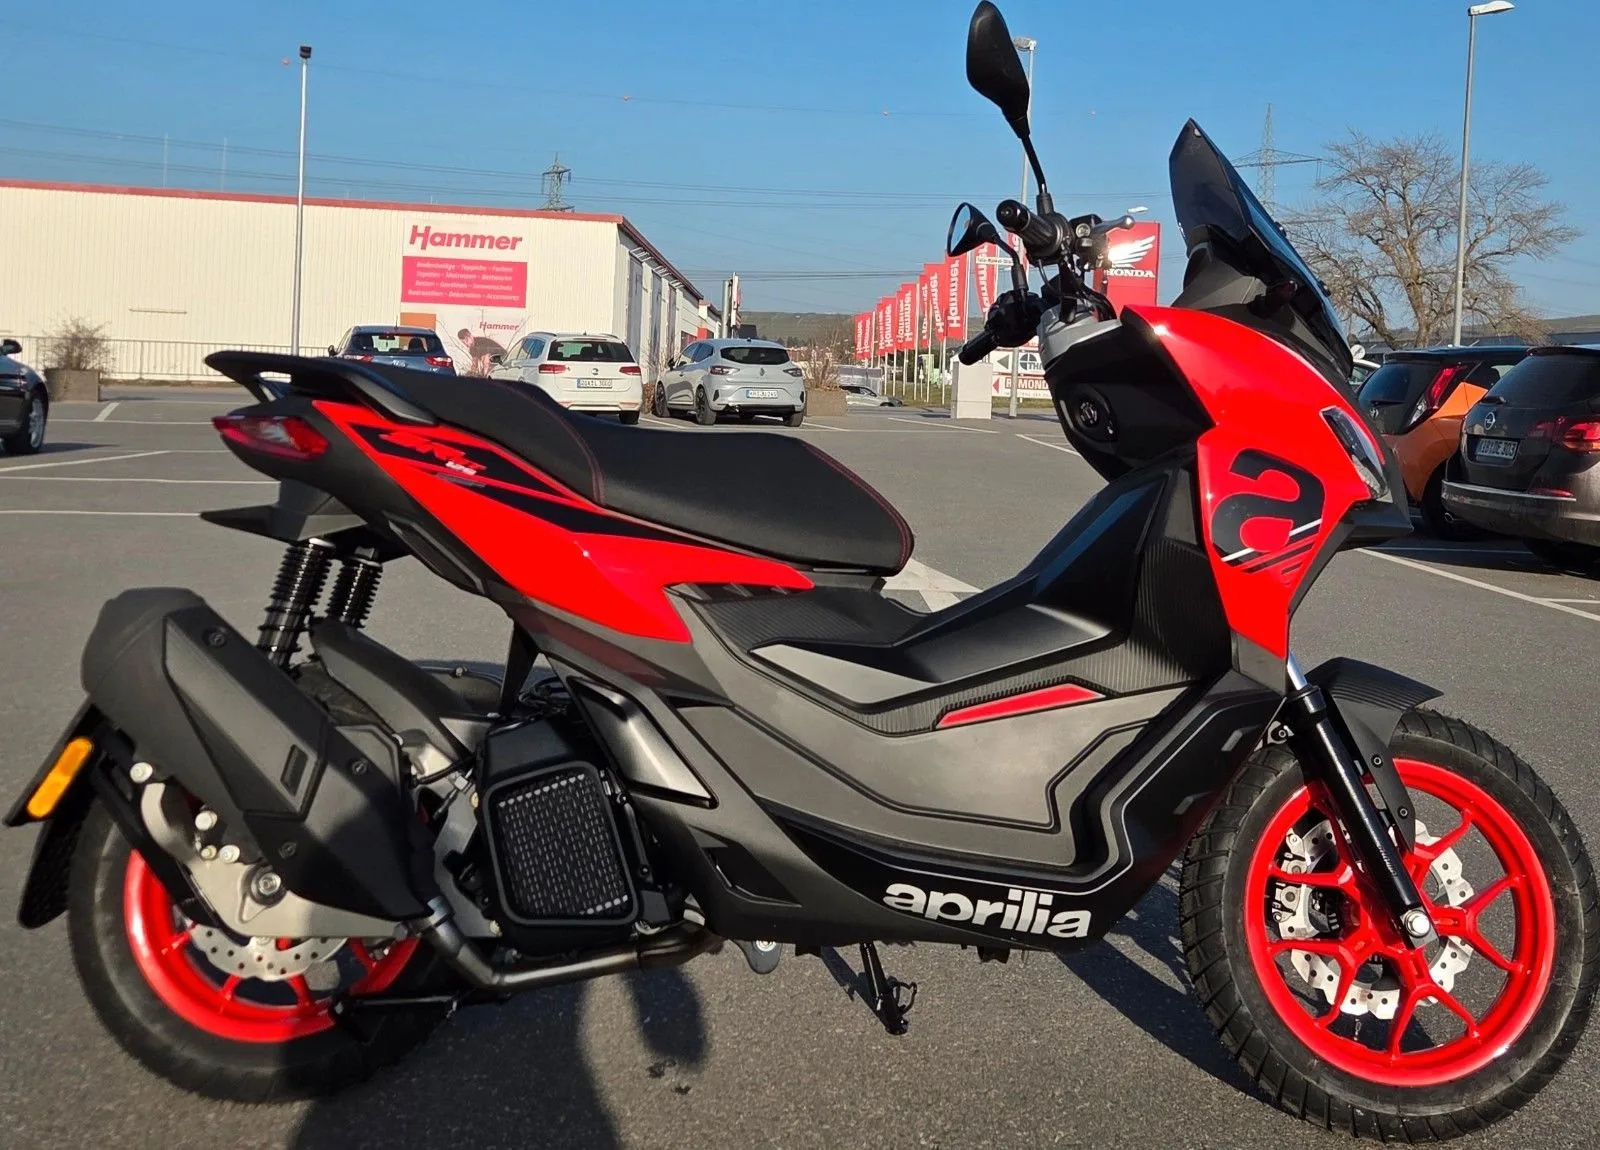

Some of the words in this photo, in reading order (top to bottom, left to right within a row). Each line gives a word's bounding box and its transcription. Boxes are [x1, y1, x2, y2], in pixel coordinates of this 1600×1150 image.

[409, 225, 523, 251] Hammer
[929, 272, 945, 333] Hammer
[947, 259, 961, 328] Hammer
[479, 322, 520, 332] Hammer
[882, 883, 1092, 938] aprilia
